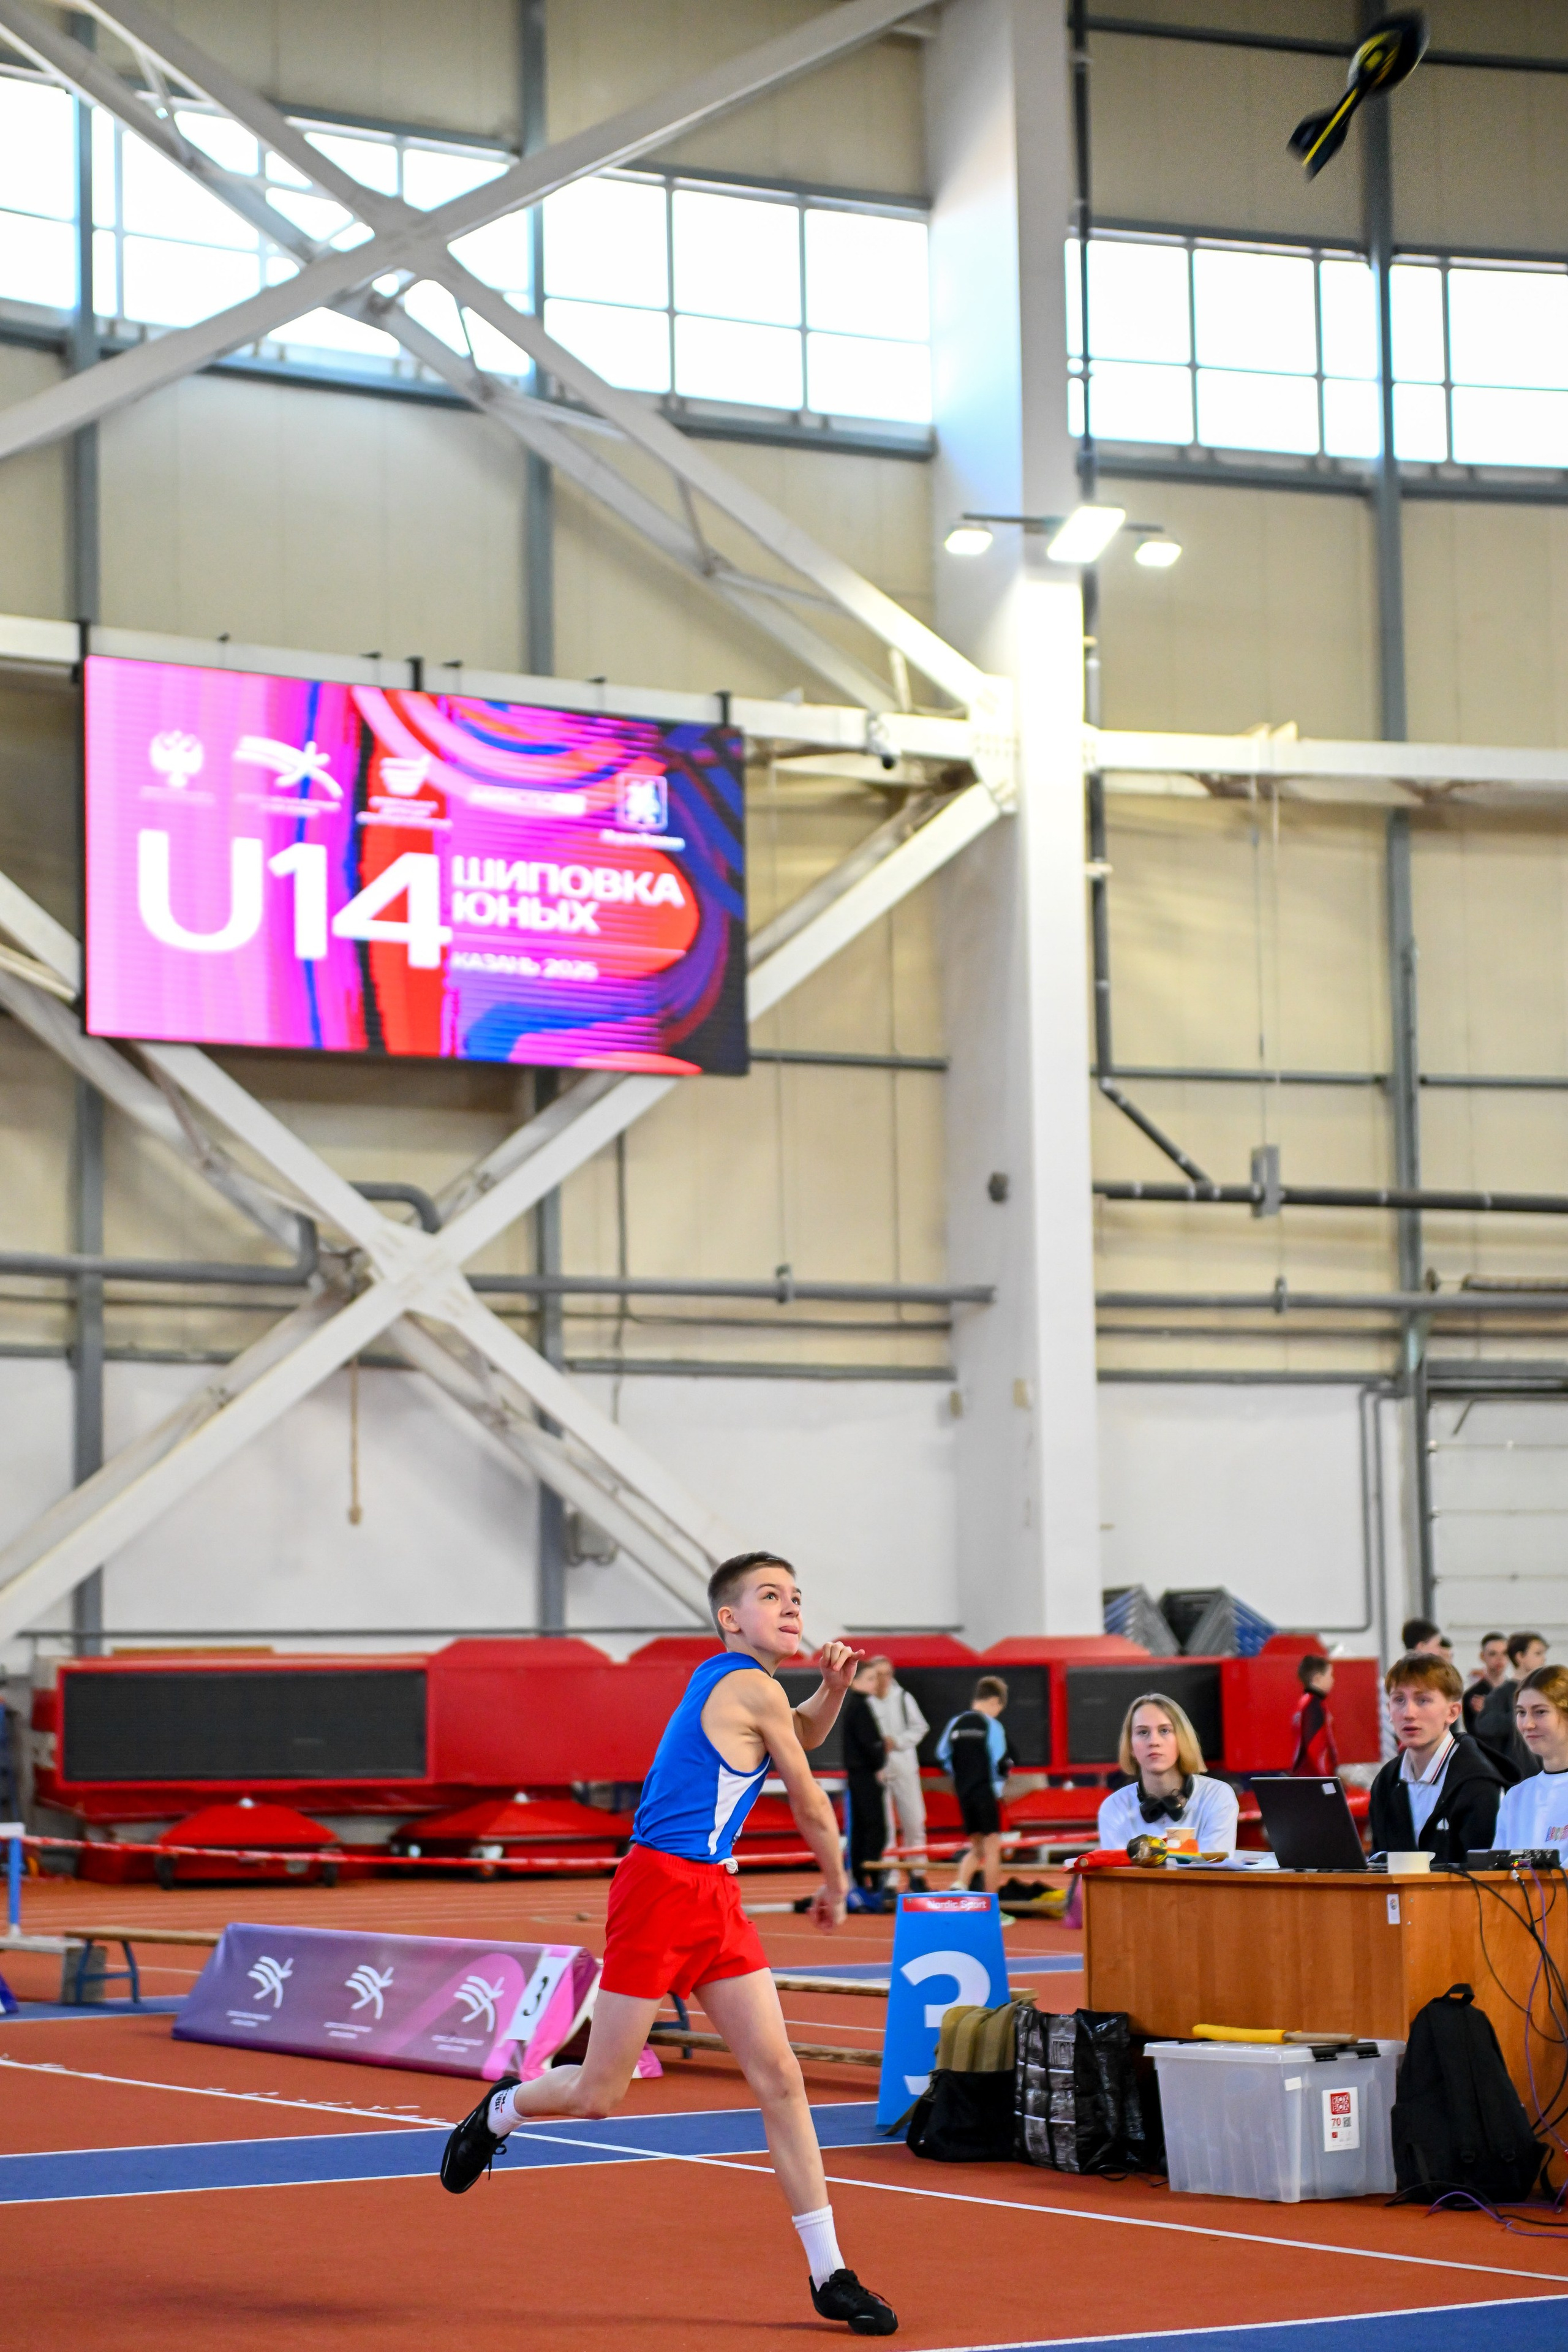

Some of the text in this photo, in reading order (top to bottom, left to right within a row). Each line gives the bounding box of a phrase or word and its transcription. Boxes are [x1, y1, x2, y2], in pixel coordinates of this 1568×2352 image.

[137, 829, 453, 970] U14
[452, 855, 685, 908] ШИПОВКА
[452, 891, 601, 935] ЮНЫХ
[927, 1900, 987, 1911] Nordic Sport
[1330, 2117, 1341, 2126] 70
